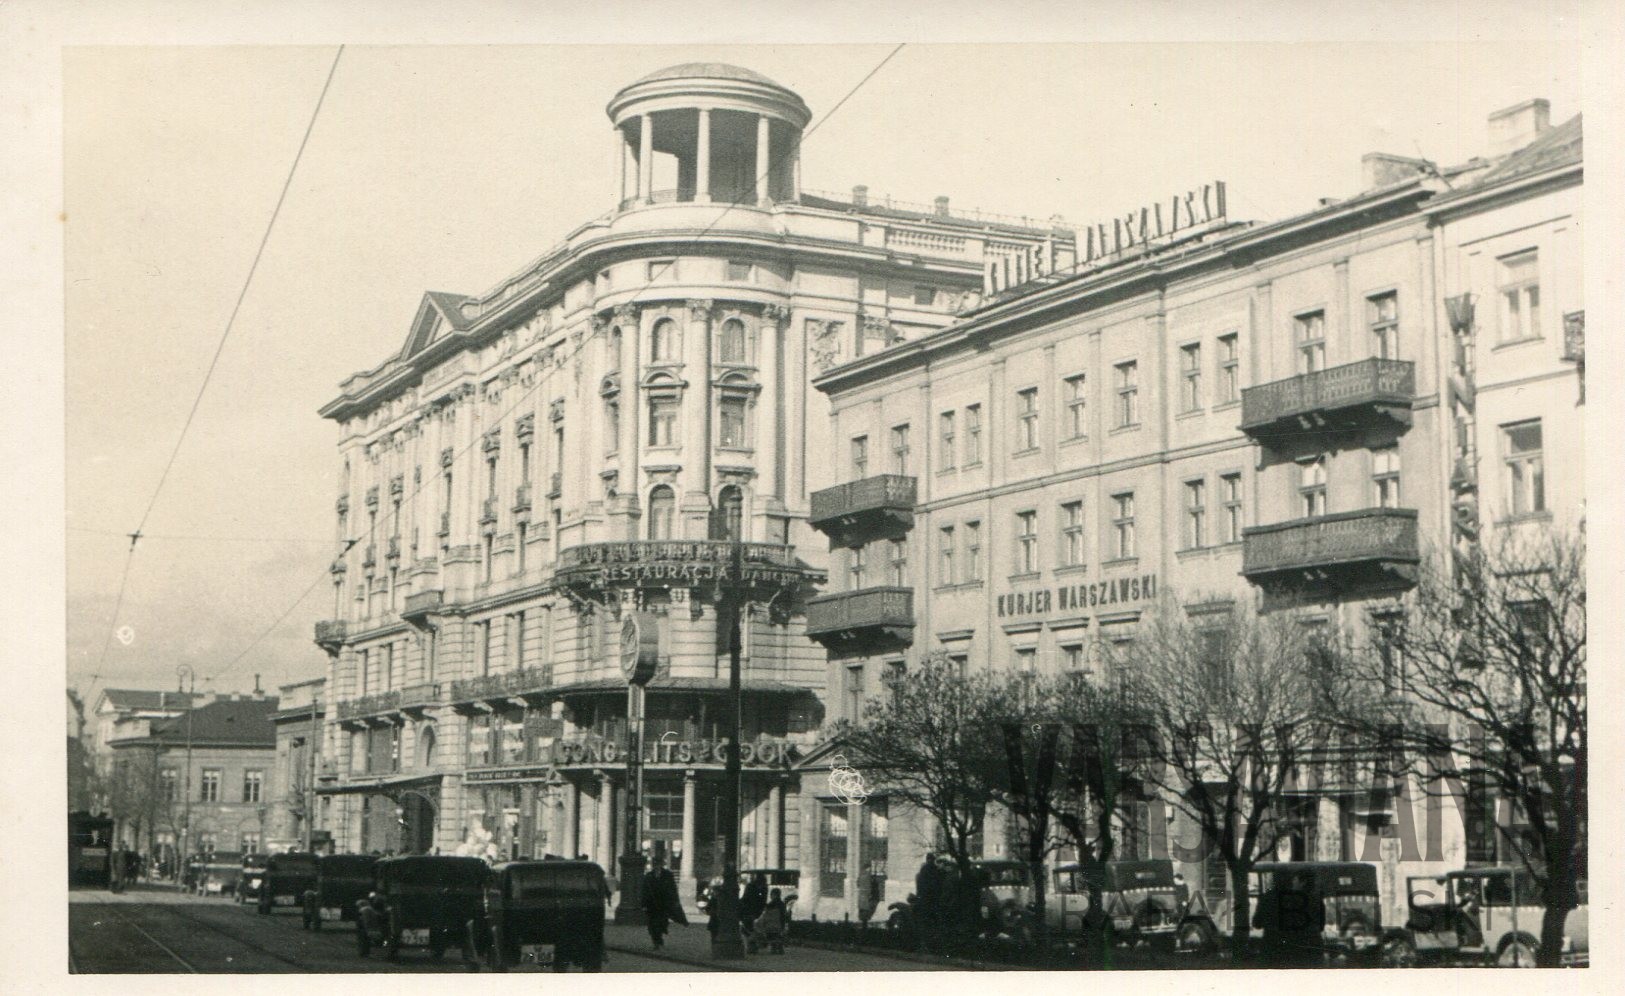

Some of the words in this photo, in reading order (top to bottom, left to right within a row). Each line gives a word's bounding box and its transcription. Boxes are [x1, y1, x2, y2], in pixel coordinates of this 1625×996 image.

[601, 564, 728, 581] RESTAURACJA
[997, 589, 1051, 617] KURJER
[1058, 574, 1157, 610] WARSZAWSKI
